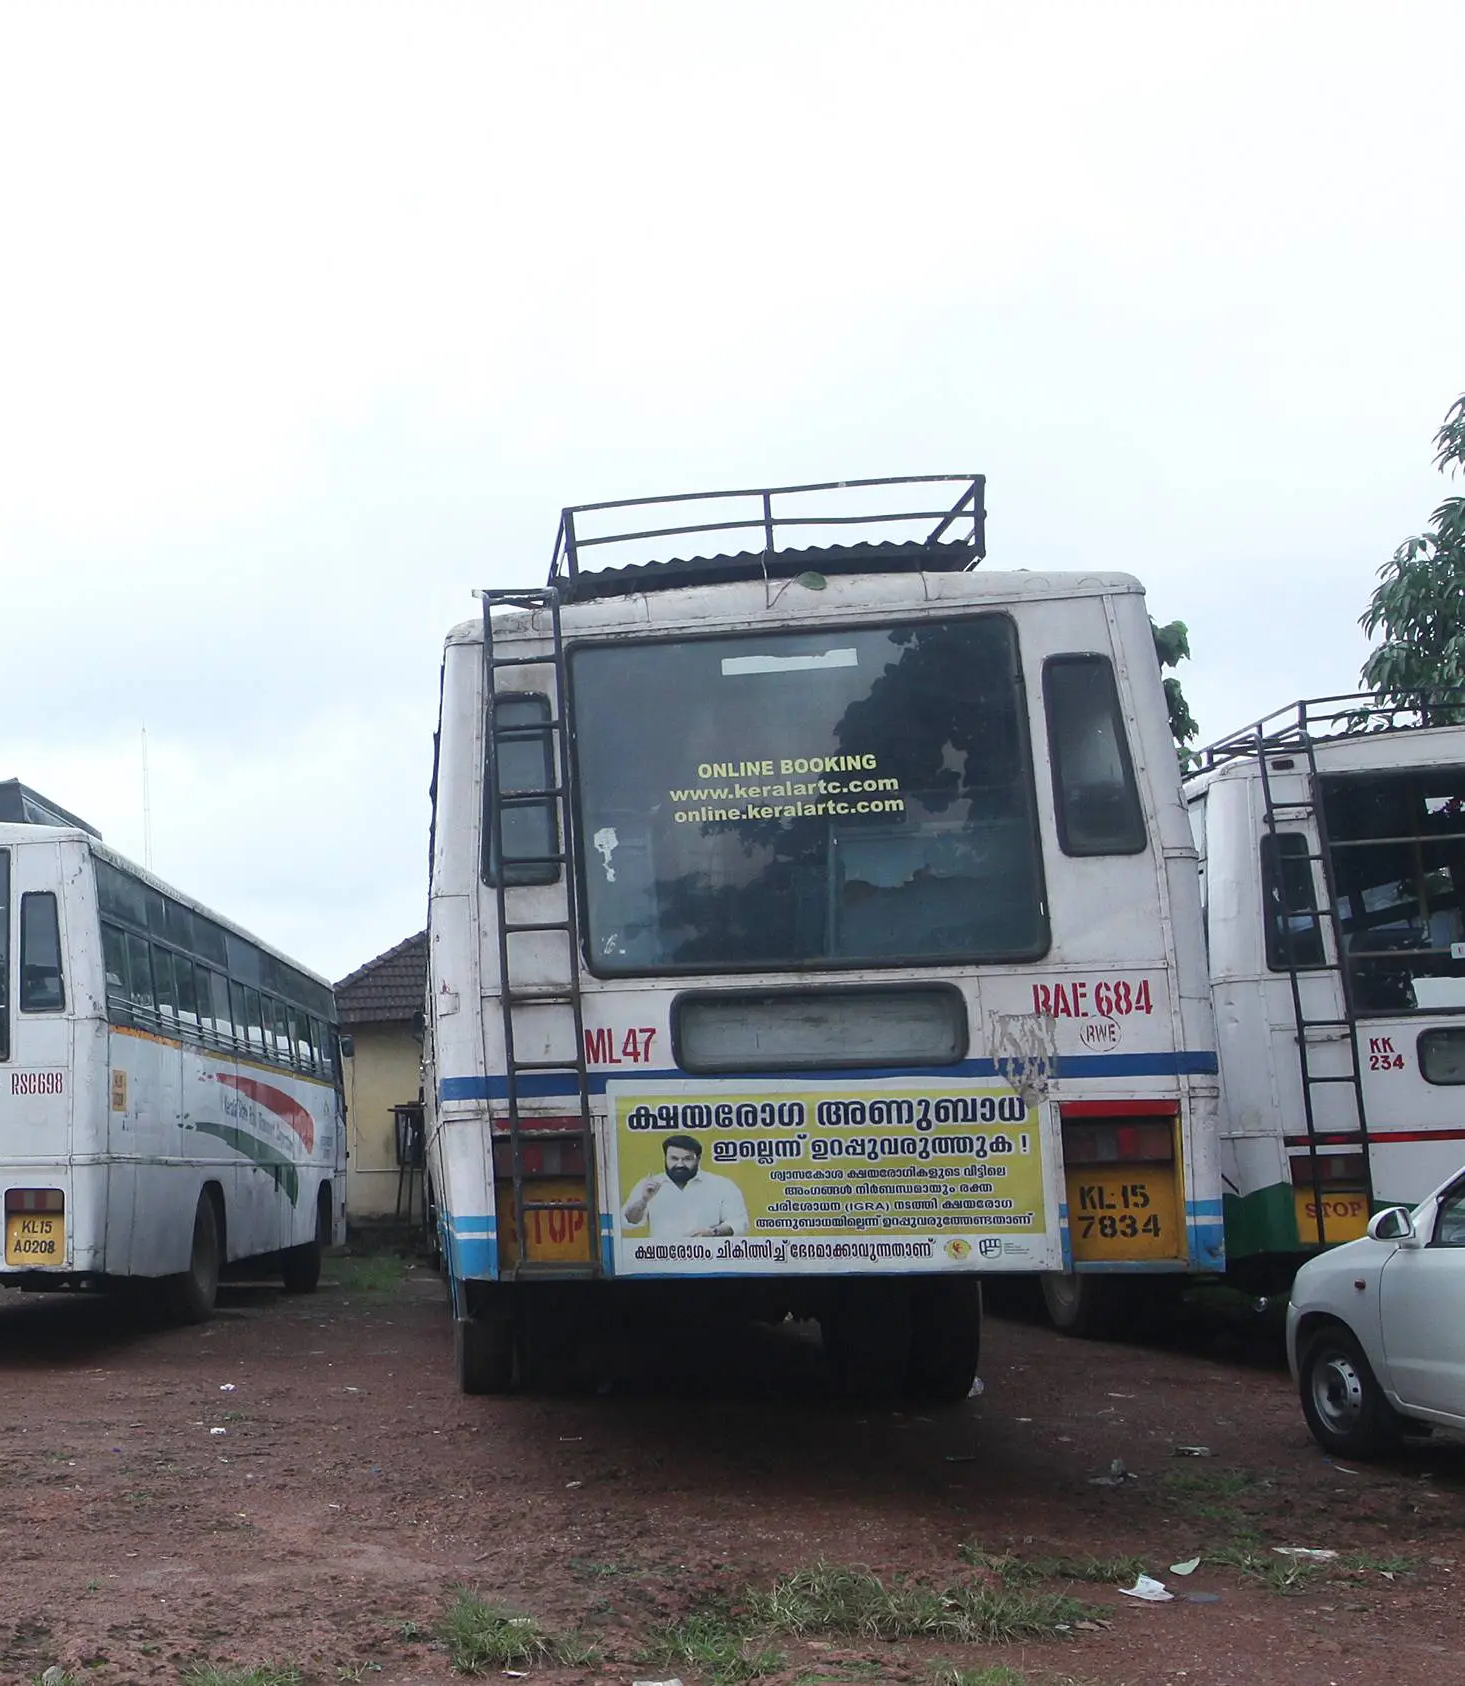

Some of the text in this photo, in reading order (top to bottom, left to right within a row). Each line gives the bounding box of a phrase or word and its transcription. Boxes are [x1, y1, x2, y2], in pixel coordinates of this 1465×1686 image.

[698, 754, 877, 779] ONLINE BOOKING
[670, 777, 899, 801] www.keralartc.com
[674, 798, 905, 823] online.keralartc.com
[1094, 979, 1153, 1016] 684
[1369, 1037, 1395, 1054] KK
[1369, 1054, 1405, 1071] 234
[628, 1097, 1026, 1132] ക്ഷയരോഗ അണുബാധ
[713, 1133, 808, 1165] ഇല്ലെന്ന്
[845, 1202, 890, 1213] (IGRA)
[1077, 1213, 1162, 1240] 7834
[635, 1244, 712, 1260] ക്ഷയരോഗം
